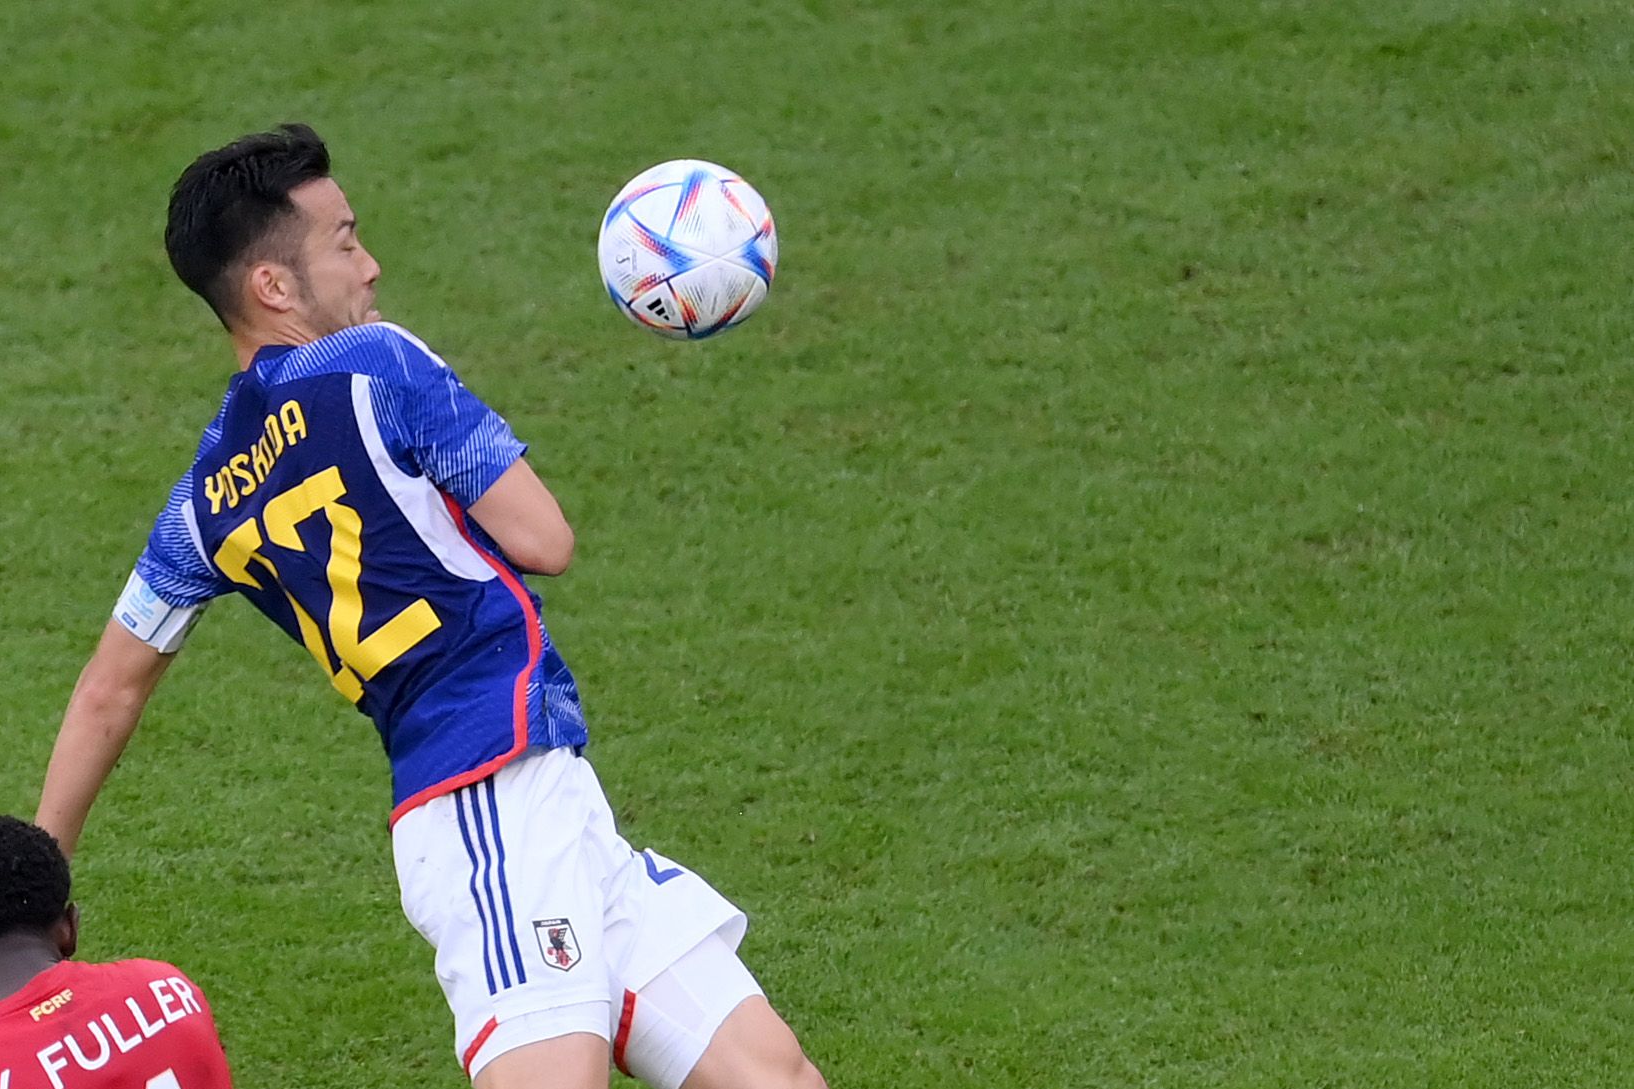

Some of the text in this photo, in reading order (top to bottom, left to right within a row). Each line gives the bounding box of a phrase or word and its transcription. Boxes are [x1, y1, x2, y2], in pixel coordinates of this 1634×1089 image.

[205, 399, 307, 515] YOSHIDA
[213, 465, 442, 704] 22
[29, 988, 74, 1022] FCRF
